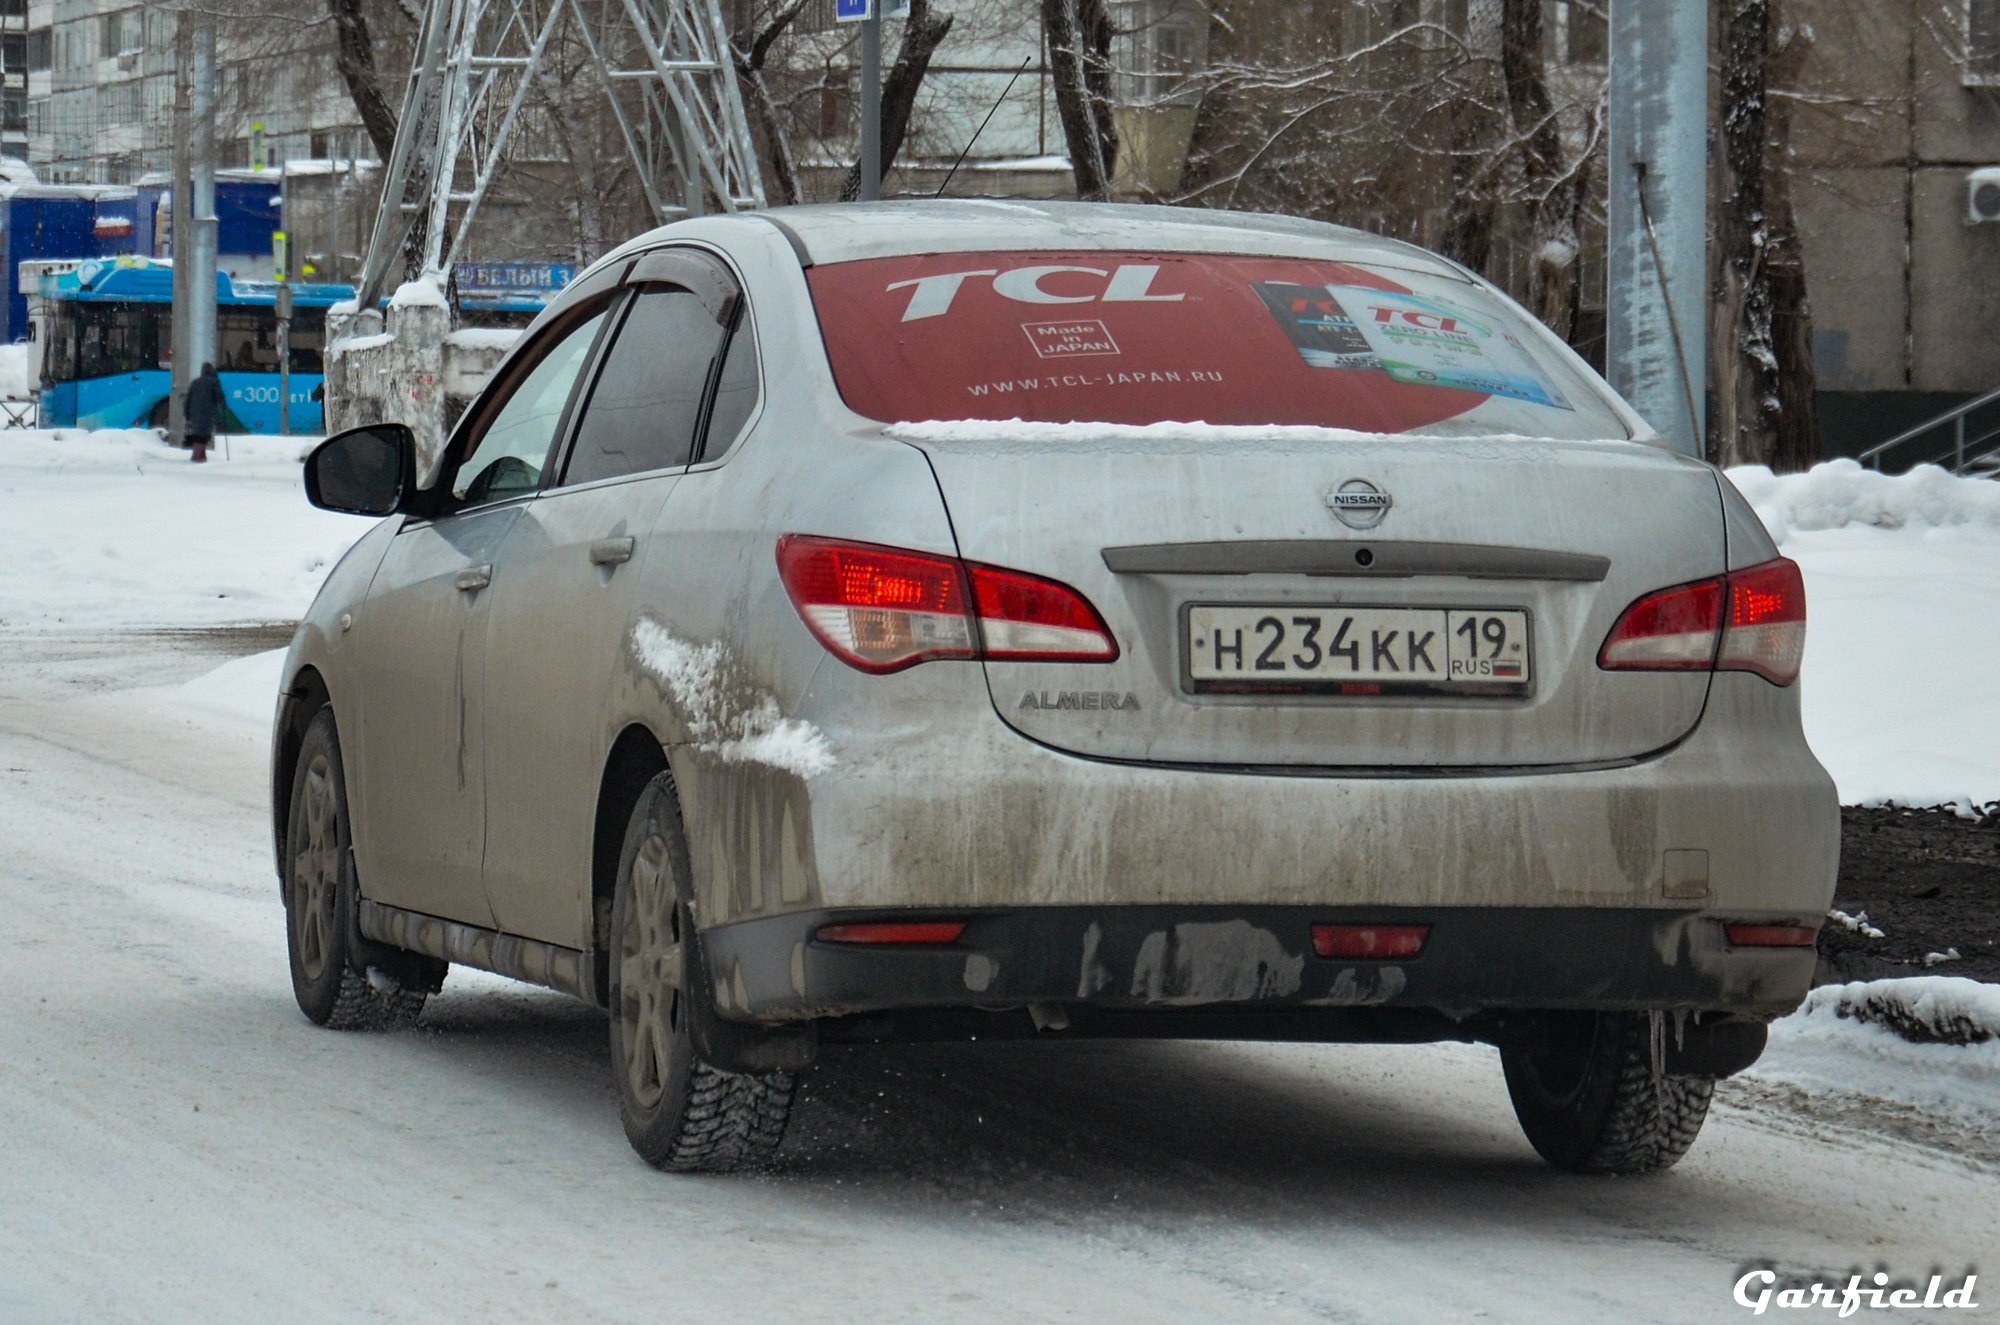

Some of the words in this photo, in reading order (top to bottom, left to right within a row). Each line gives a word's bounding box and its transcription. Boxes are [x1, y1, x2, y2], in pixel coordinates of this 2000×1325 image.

[477, 266, 552, 287] БЕЛЫЙ
[886, 264, 1186, 322] TCL
[1367, 305, 1468, 335] TCL
[1037, 326, 1095, 335] Made
[1062, 335, 1082, 343] in
[1044, 342, 1110, 353] JAPAN
[968, 371, 1223, 396] WWW.TCL-JAPAN.RU
[1334, 495, 1387, 504] NISSAN
[1456, 617, 1507, 660] 19
[1451, 659, 1491, 675] RUS
[1019, 690, 1142, 710] ALMERA
